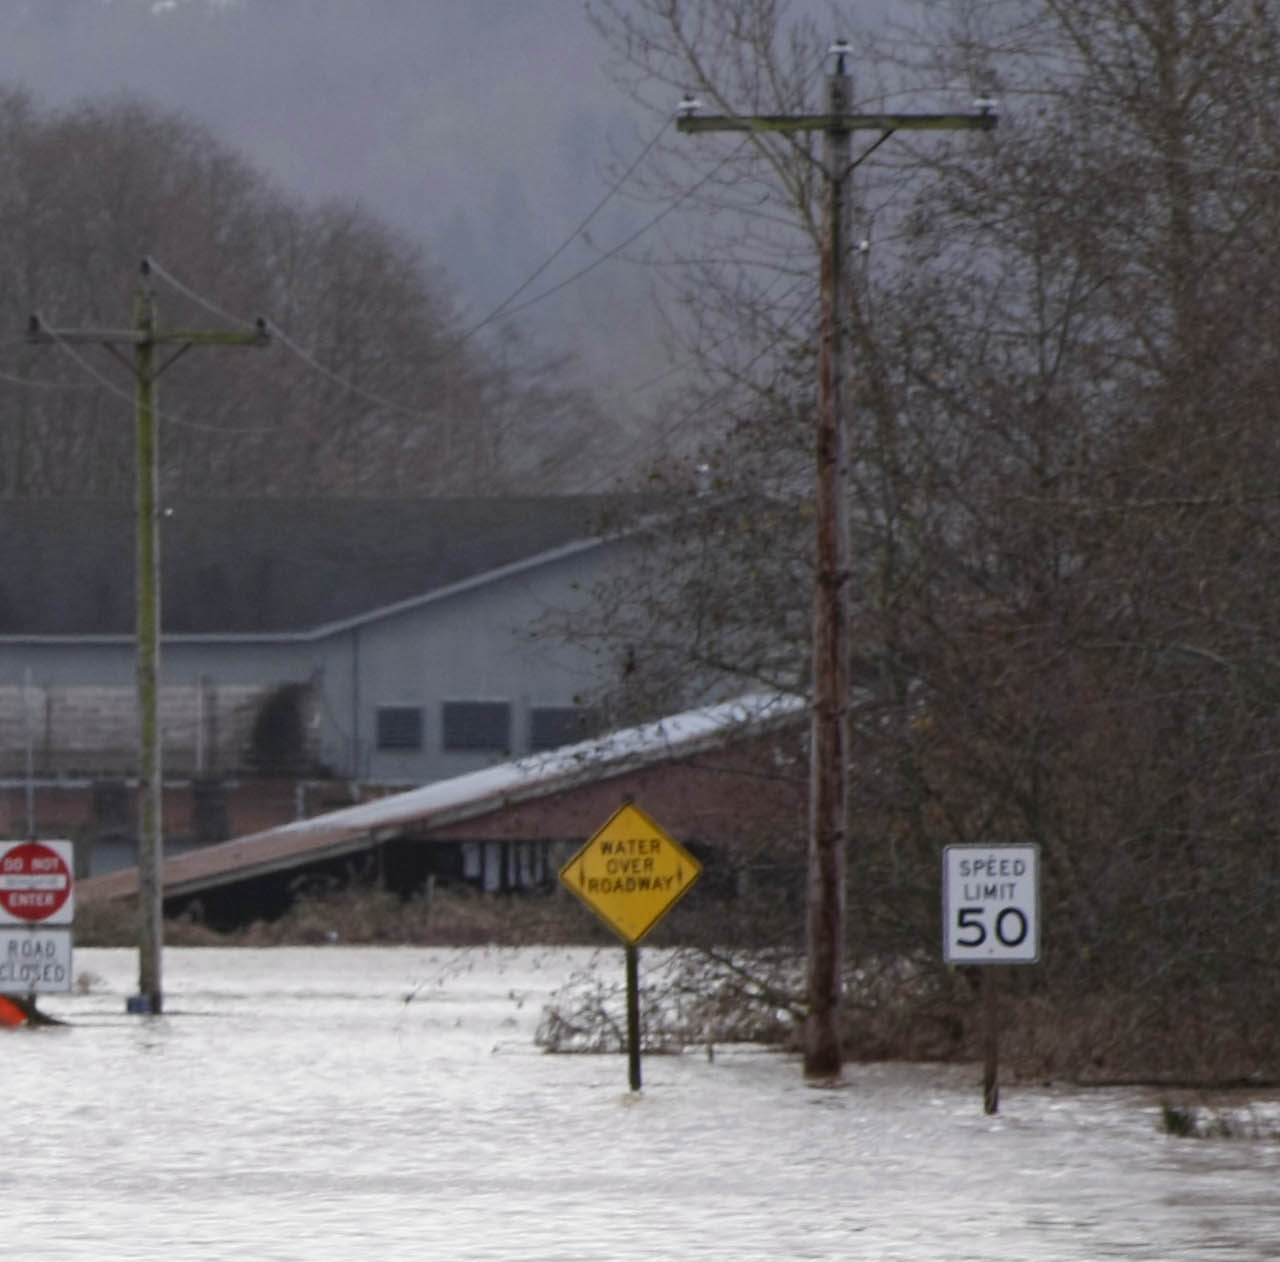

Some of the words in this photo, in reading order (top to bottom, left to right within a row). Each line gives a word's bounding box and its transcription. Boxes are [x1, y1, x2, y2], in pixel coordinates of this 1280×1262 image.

[600, 839, 661, 856] WATER
[3, 857, 23, 872] DO
[31, 857, 59, 871] NOT
[606, 857, 654, 875] OVER
[959, 859, 1026, 877] SPEED
[588, 875, 673, 894] ROADWAY
[964, 882, 1016, 901] LIMIT
[9, 892, 55, 907] ENTER
[956, 907, 1028, 948] 50
[8, 939, 56, 958] ROAD
